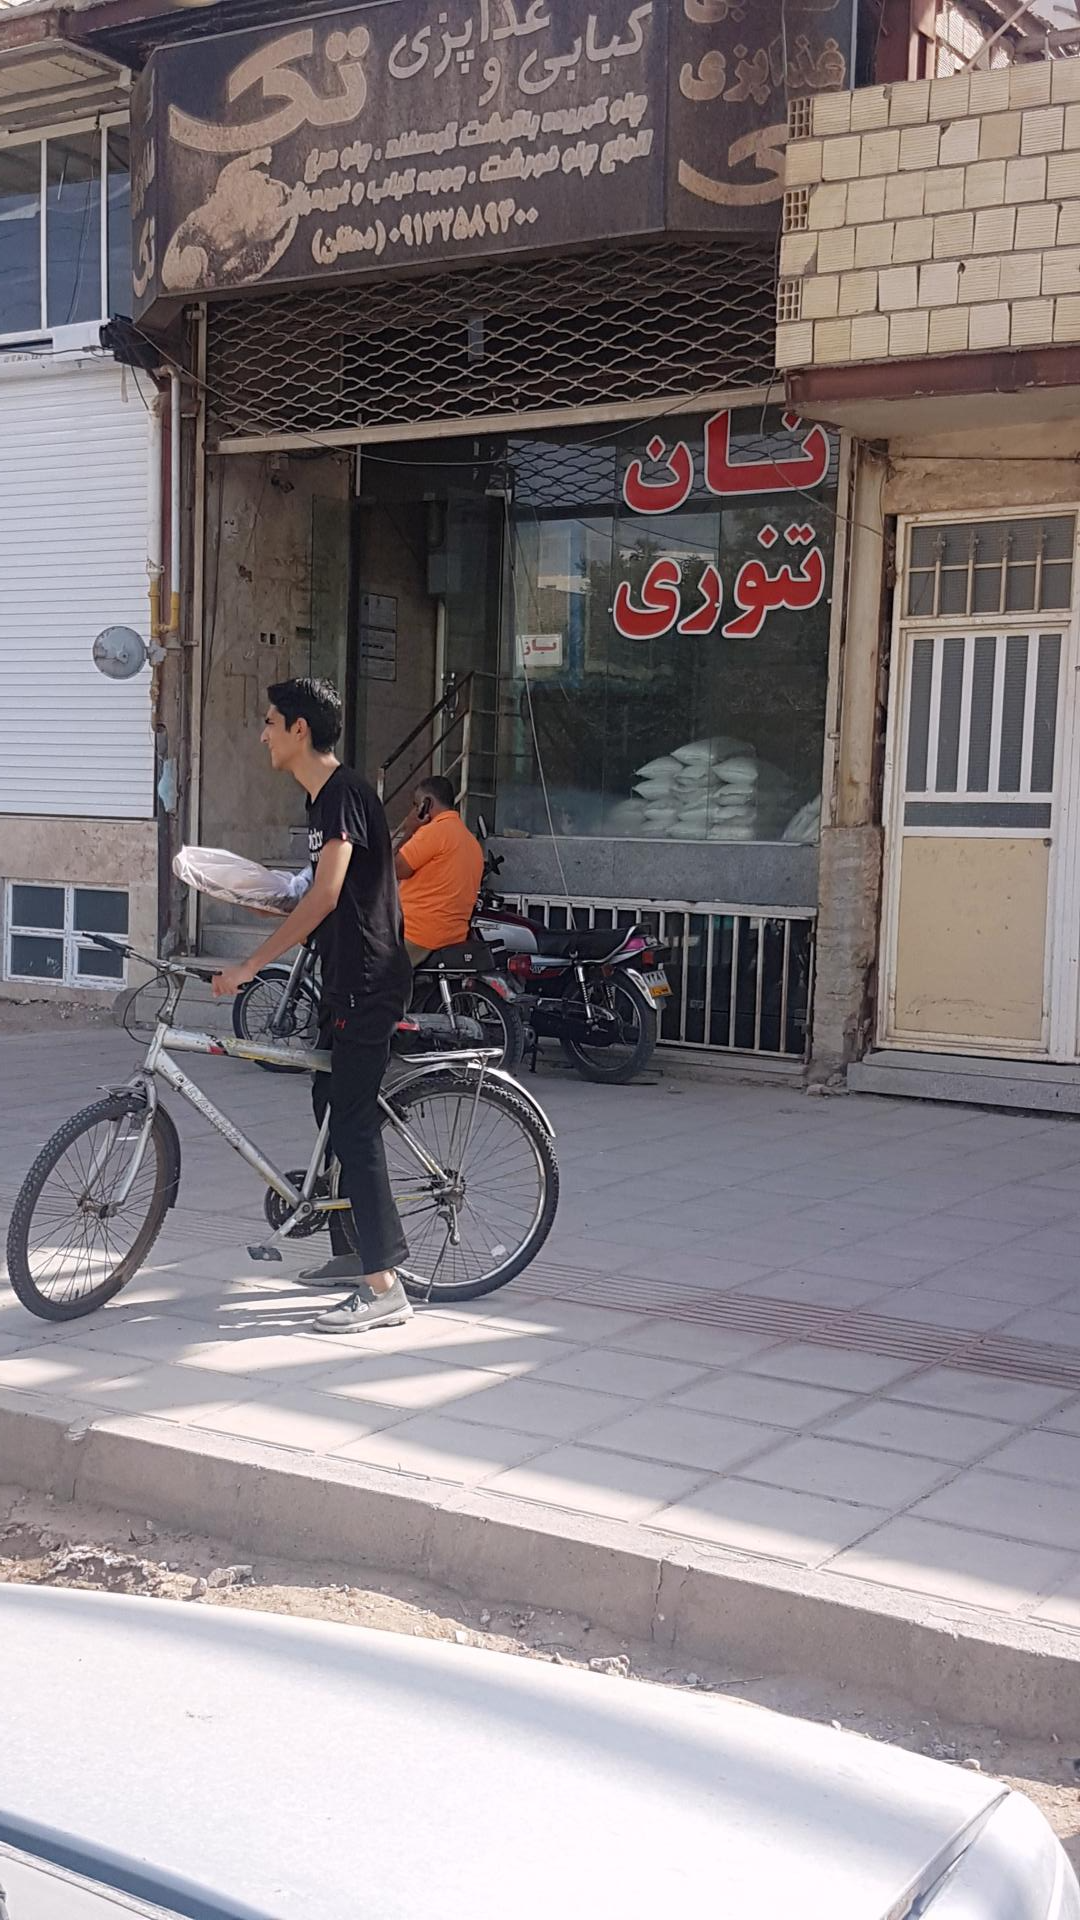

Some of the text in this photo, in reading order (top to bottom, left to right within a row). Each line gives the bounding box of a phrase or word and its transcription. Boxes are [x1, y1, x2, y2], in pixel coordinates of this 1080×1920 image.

[518, 2, 653, 95] کبابی
[168, 26, 370, 153] تک
[477, 57, 502, 107] و
[609, 92, 648, 127] چلو
[340, 140, 372, 173] چلو
[561, 140, 599, 178] چلو
[623, 408, 831, 515] نان
[612, 522, 826, 641] تنوری
[523, 639, 557, 655] باز
